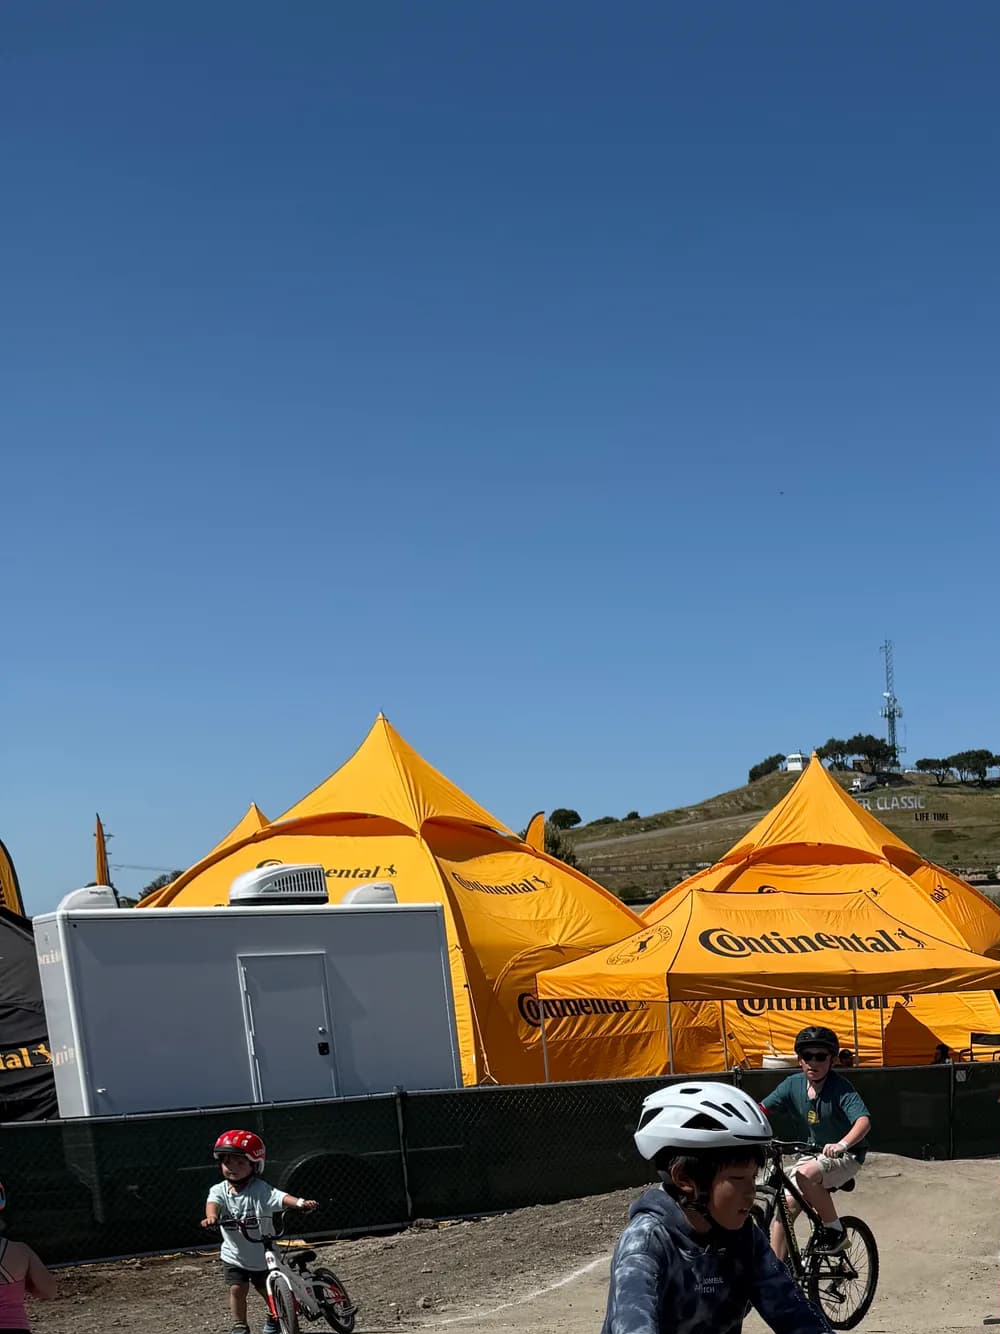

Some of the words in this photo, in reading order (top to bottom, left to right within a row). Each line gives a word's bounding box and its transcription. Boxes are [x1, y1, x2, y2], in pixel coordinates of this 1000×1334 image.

[877, 796, 926, 810] CLASSIC
[914, 812, 930, 821] LIFE
[698, 928, 906, 958] Continental
